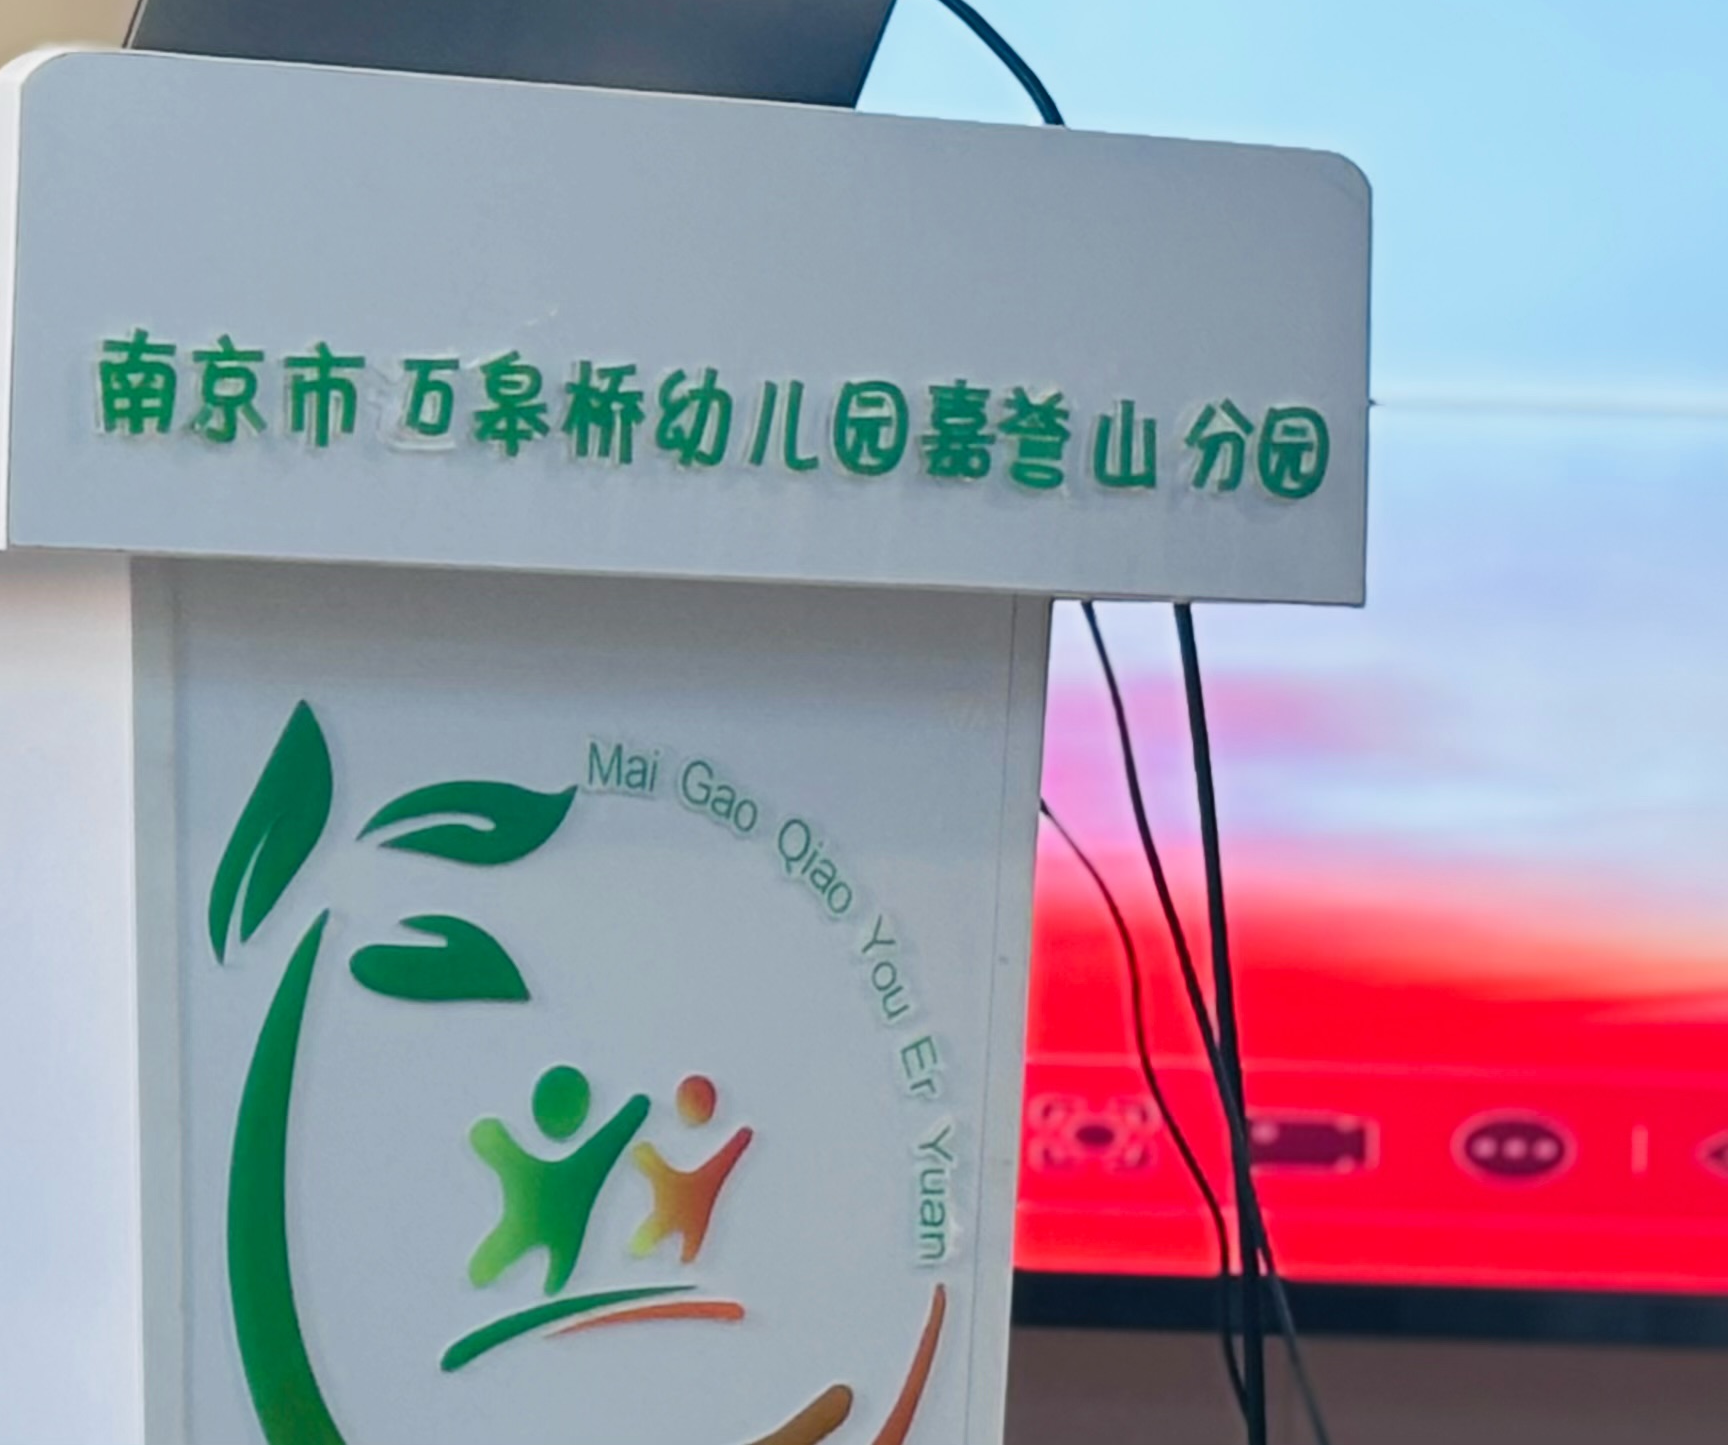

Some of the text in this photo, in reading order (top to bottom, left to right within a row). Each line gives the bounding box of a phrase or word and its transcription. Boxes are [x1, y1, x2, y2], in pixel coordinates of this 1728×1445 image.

[587, 741, 954, 1261] Mai Gao Qiao You Er Yuan
